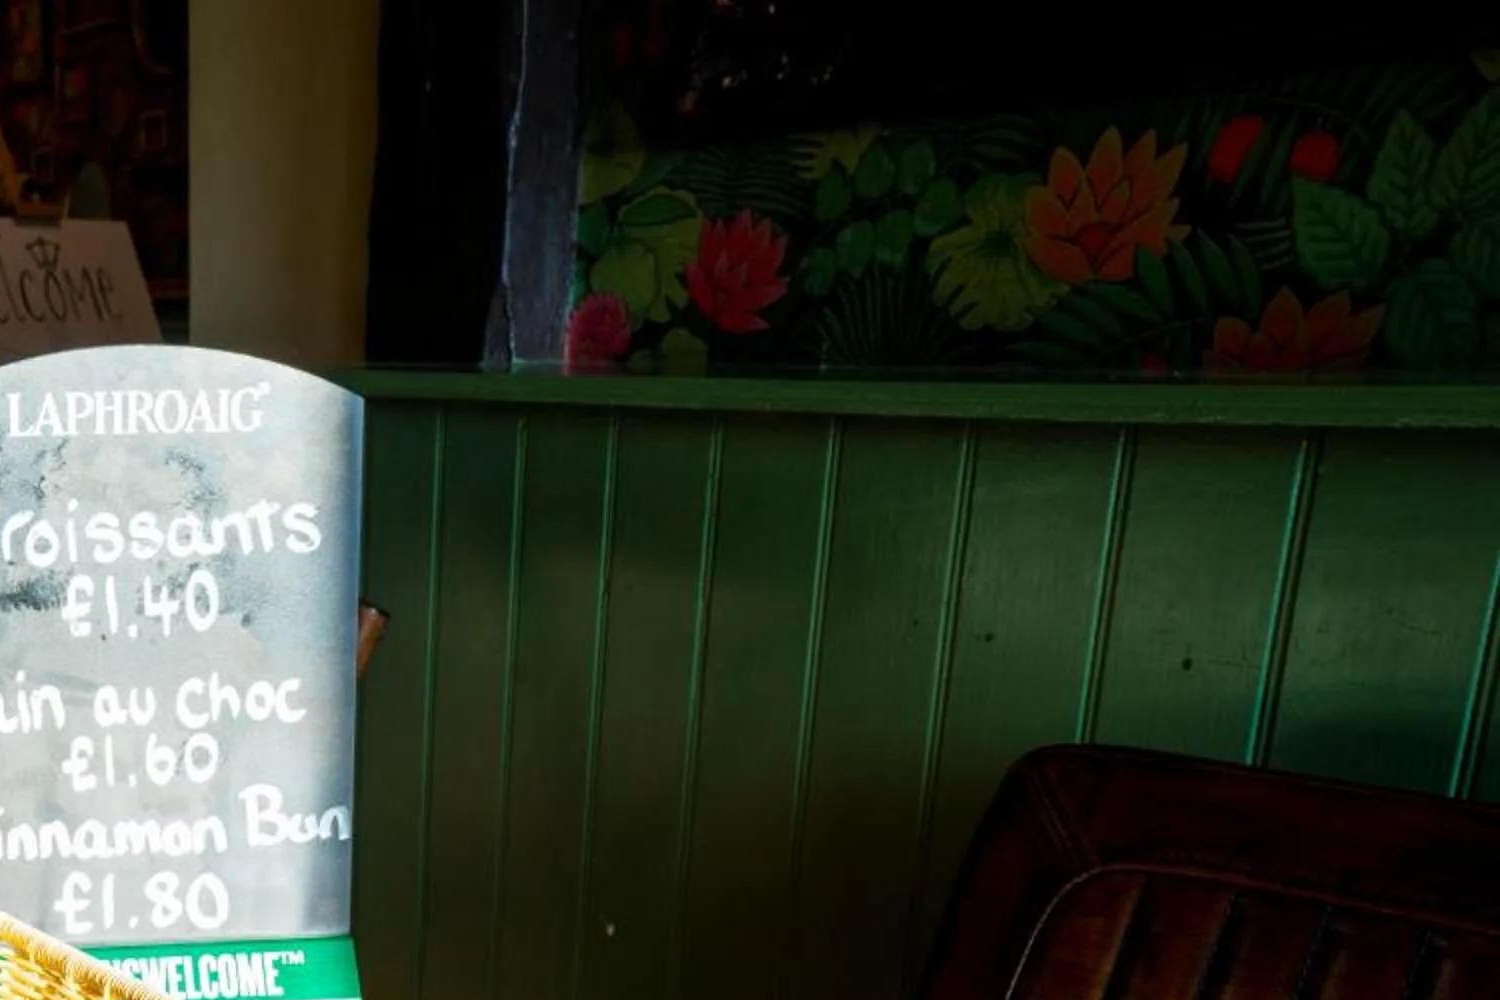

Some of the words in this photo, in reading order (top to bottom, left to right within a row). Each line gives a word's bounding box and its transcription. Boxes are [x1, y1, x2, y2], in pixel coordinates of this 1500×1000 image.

[61, 570, 220, 638] £1.40
[93, 684, 156, 728] au
[61, 733, 220, 792] £1.60
[238, 783, 352, 847] Bun
[54, 871, 229, 935] £1.80
